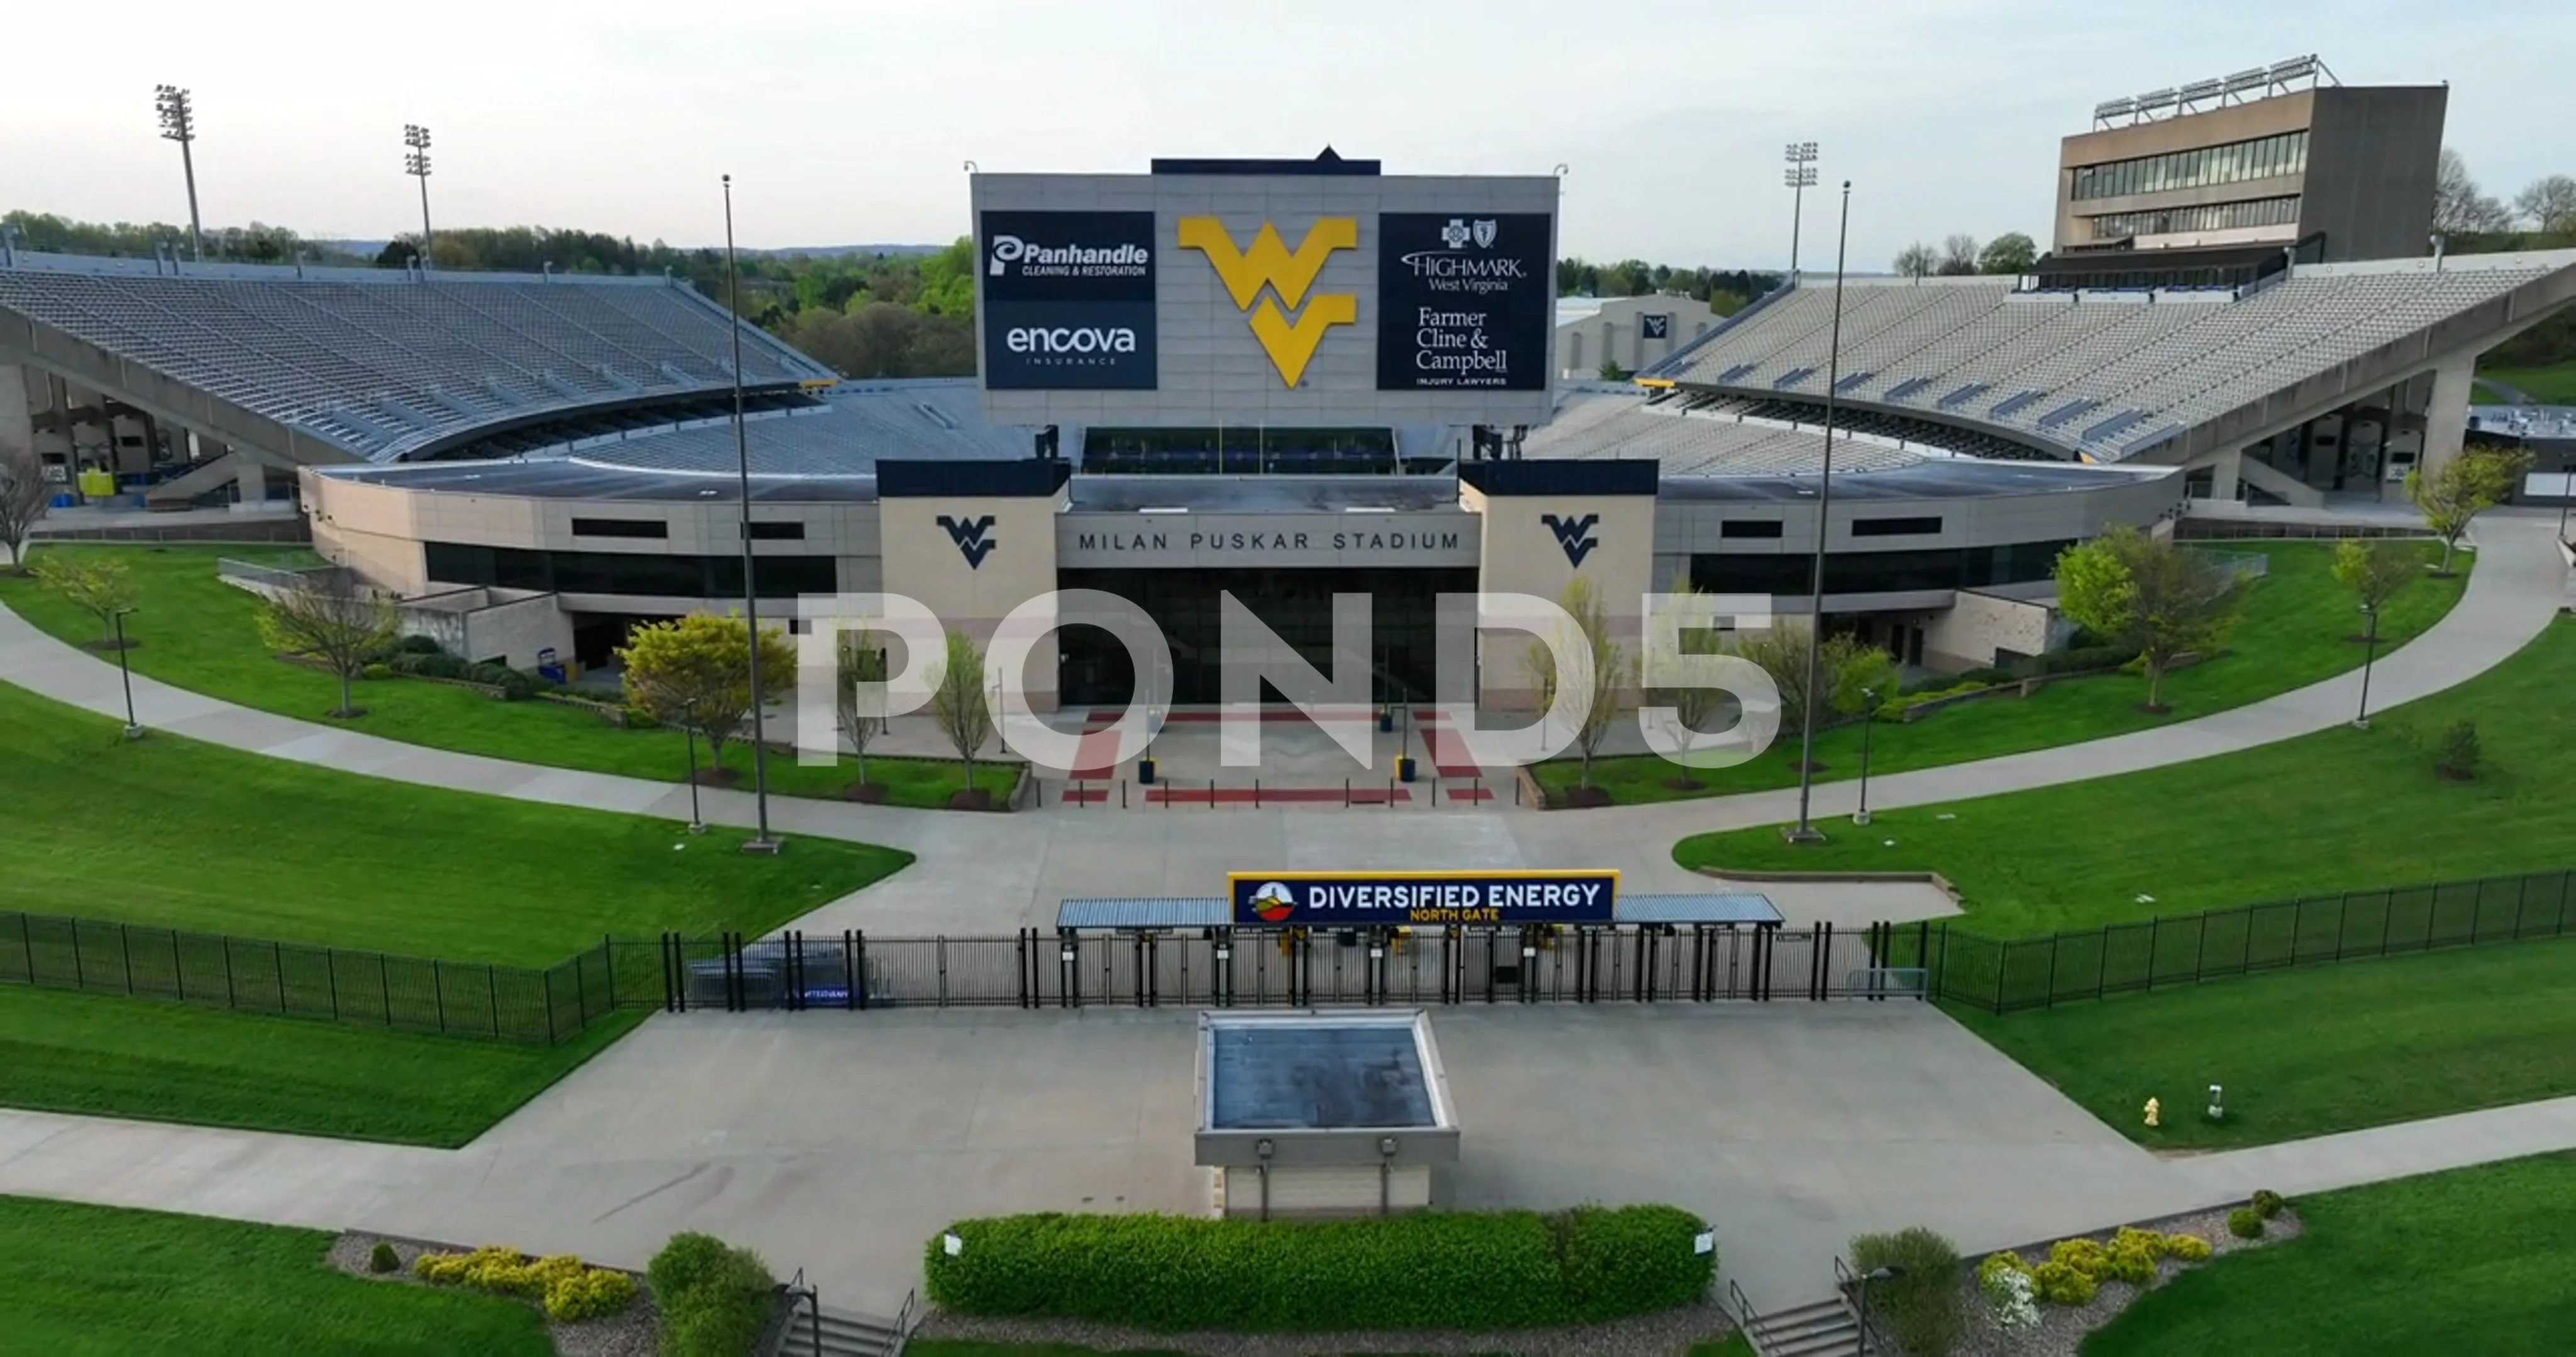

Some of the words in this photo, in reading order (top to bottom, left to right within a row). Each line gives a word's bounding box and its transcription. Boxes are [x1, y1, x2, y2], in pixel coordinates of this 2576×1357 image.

[1023, 243, 1148, 264] Panhandle
[1022, 265, 1070, 276] CLEANING
[1072, 266, 1079, 276] &
[1081, 265, 1146, 276] RESTORATION
[1413, 256, 1523, 278] HIGHMARK
[1429, 279, 1460, 291] West
[1462, 278, 1508, 295] Virginia
[1418, 307, 1487, 327] Farmer
[1006, 327, 1136, 352] encova
[1416, 328, 1467, 348] Cline
[1470, 328, 1489, 349] &
[1416, 350, 1507, 376] Campbell
[1079, 533, 1168, 550] MILAN
[1191, 533, 1309, 549] PUSKAR
[1333, 533, 1458, 549] STADIUM
[1309, 885, 1480, 909] DIVERSIFIED
[1489, 883, 1601, 907] ENERGY
[1409, 907, 1460, 921] NORTH
[1462, 907, 1499, 921] GATE
